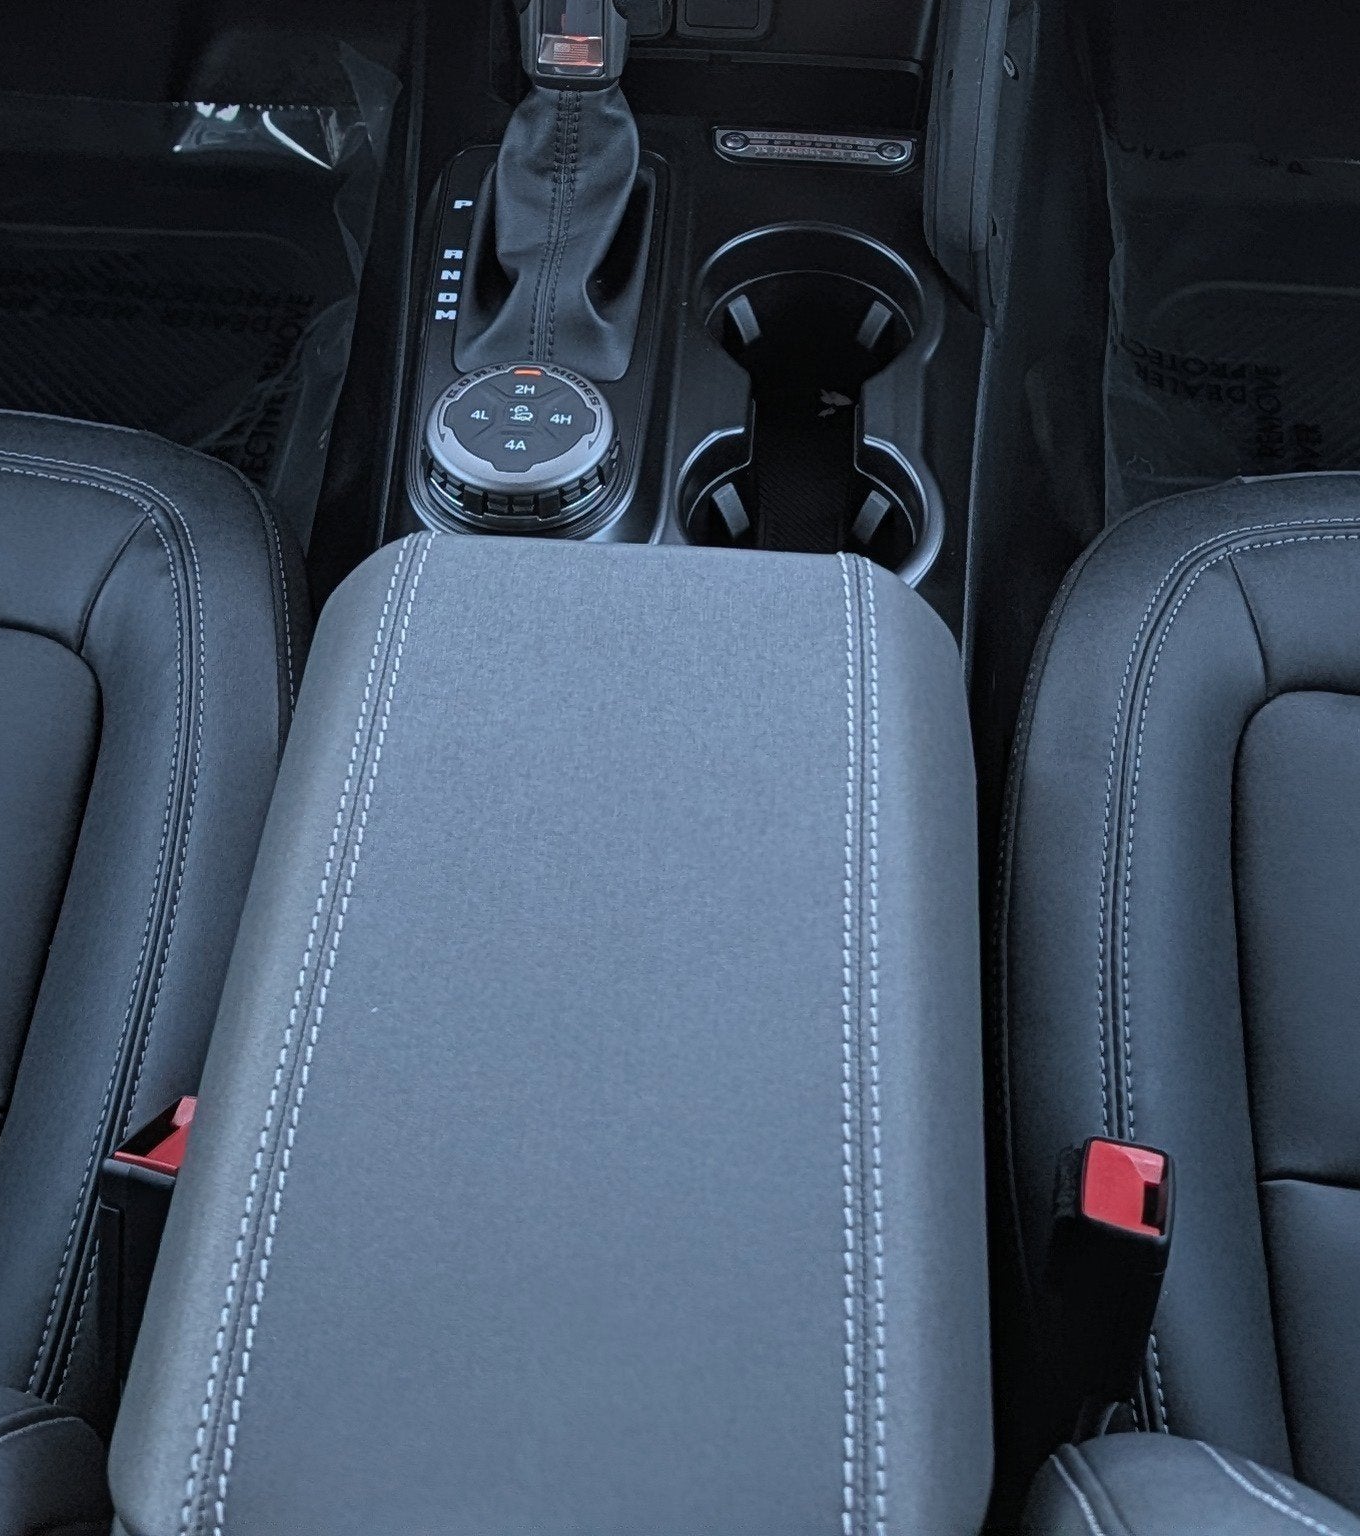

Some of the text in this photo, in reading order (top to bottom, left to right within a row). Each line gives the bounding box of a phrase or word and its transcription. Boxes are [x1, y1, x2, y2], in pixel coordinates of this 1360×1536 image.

[452, 199, 474, 210] P
[443, 249, 464, 260] R
[440, 270, 461, 280] N
[437, 292, 458, 303] D
[434, 309, 457, 321] M
[514, 384, 535, 395] 2H
[470, 409, 489, 420] 4L
[549, 413, 572, 425] 4H
[504, 439, 526, 451] 4A
